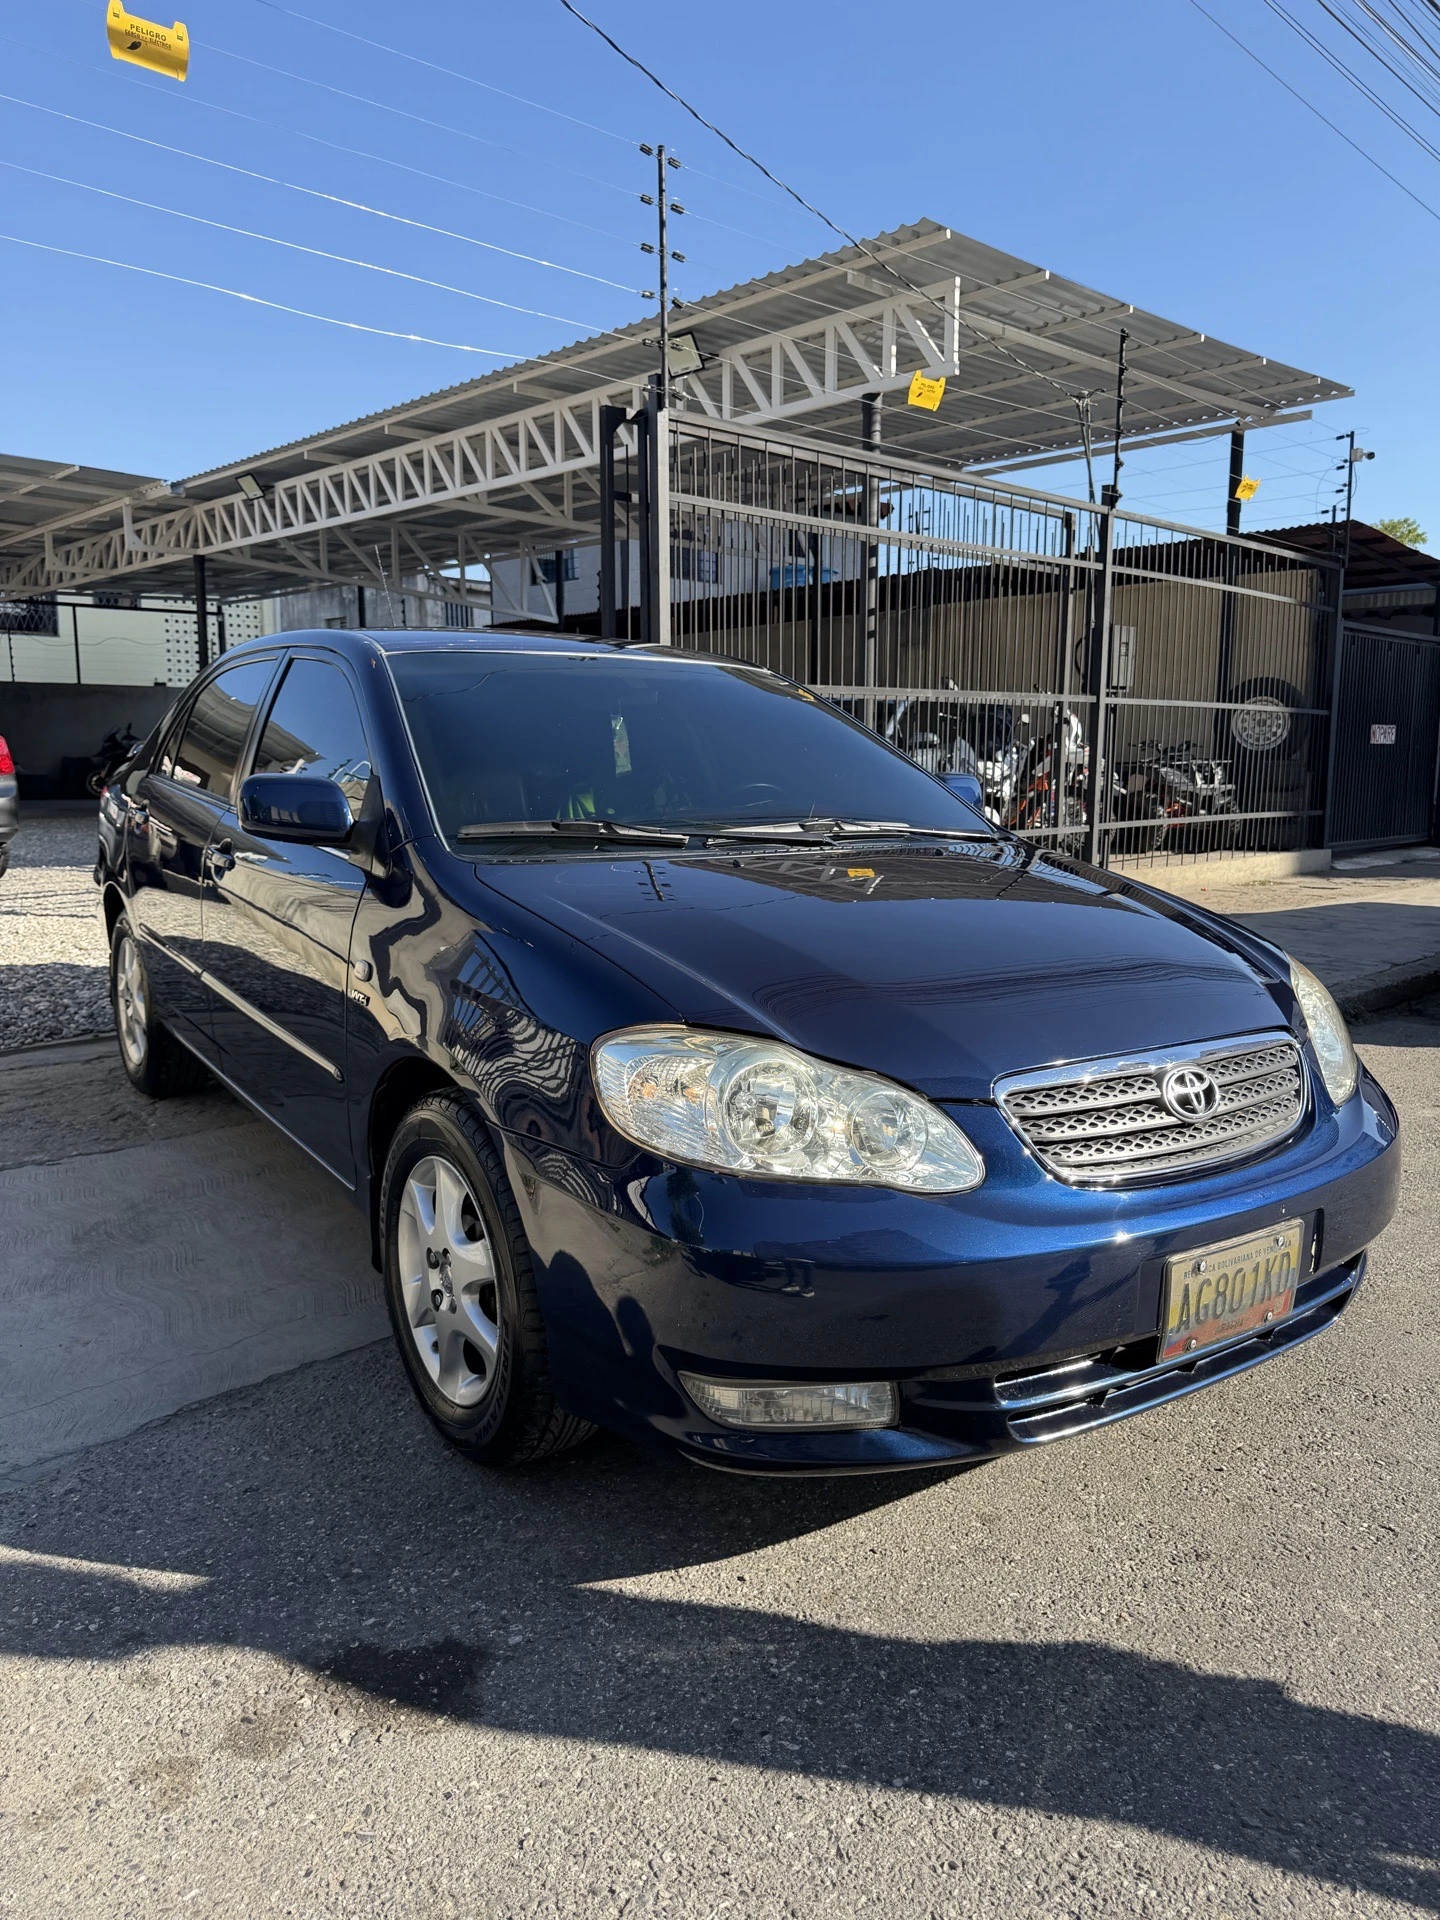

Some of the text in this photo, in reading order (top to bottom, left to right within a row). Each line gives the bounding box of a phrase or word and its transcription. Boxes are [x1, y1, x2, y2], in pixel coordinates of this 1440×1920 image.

[130, 23, 167, 42] PELIGRO
[1217, 1252, 1254, 1271] BOLIVARIANA
[1254, 1248, 1262, 1260] DE
[1175, 1251, 1291, 1334] AG801KD
